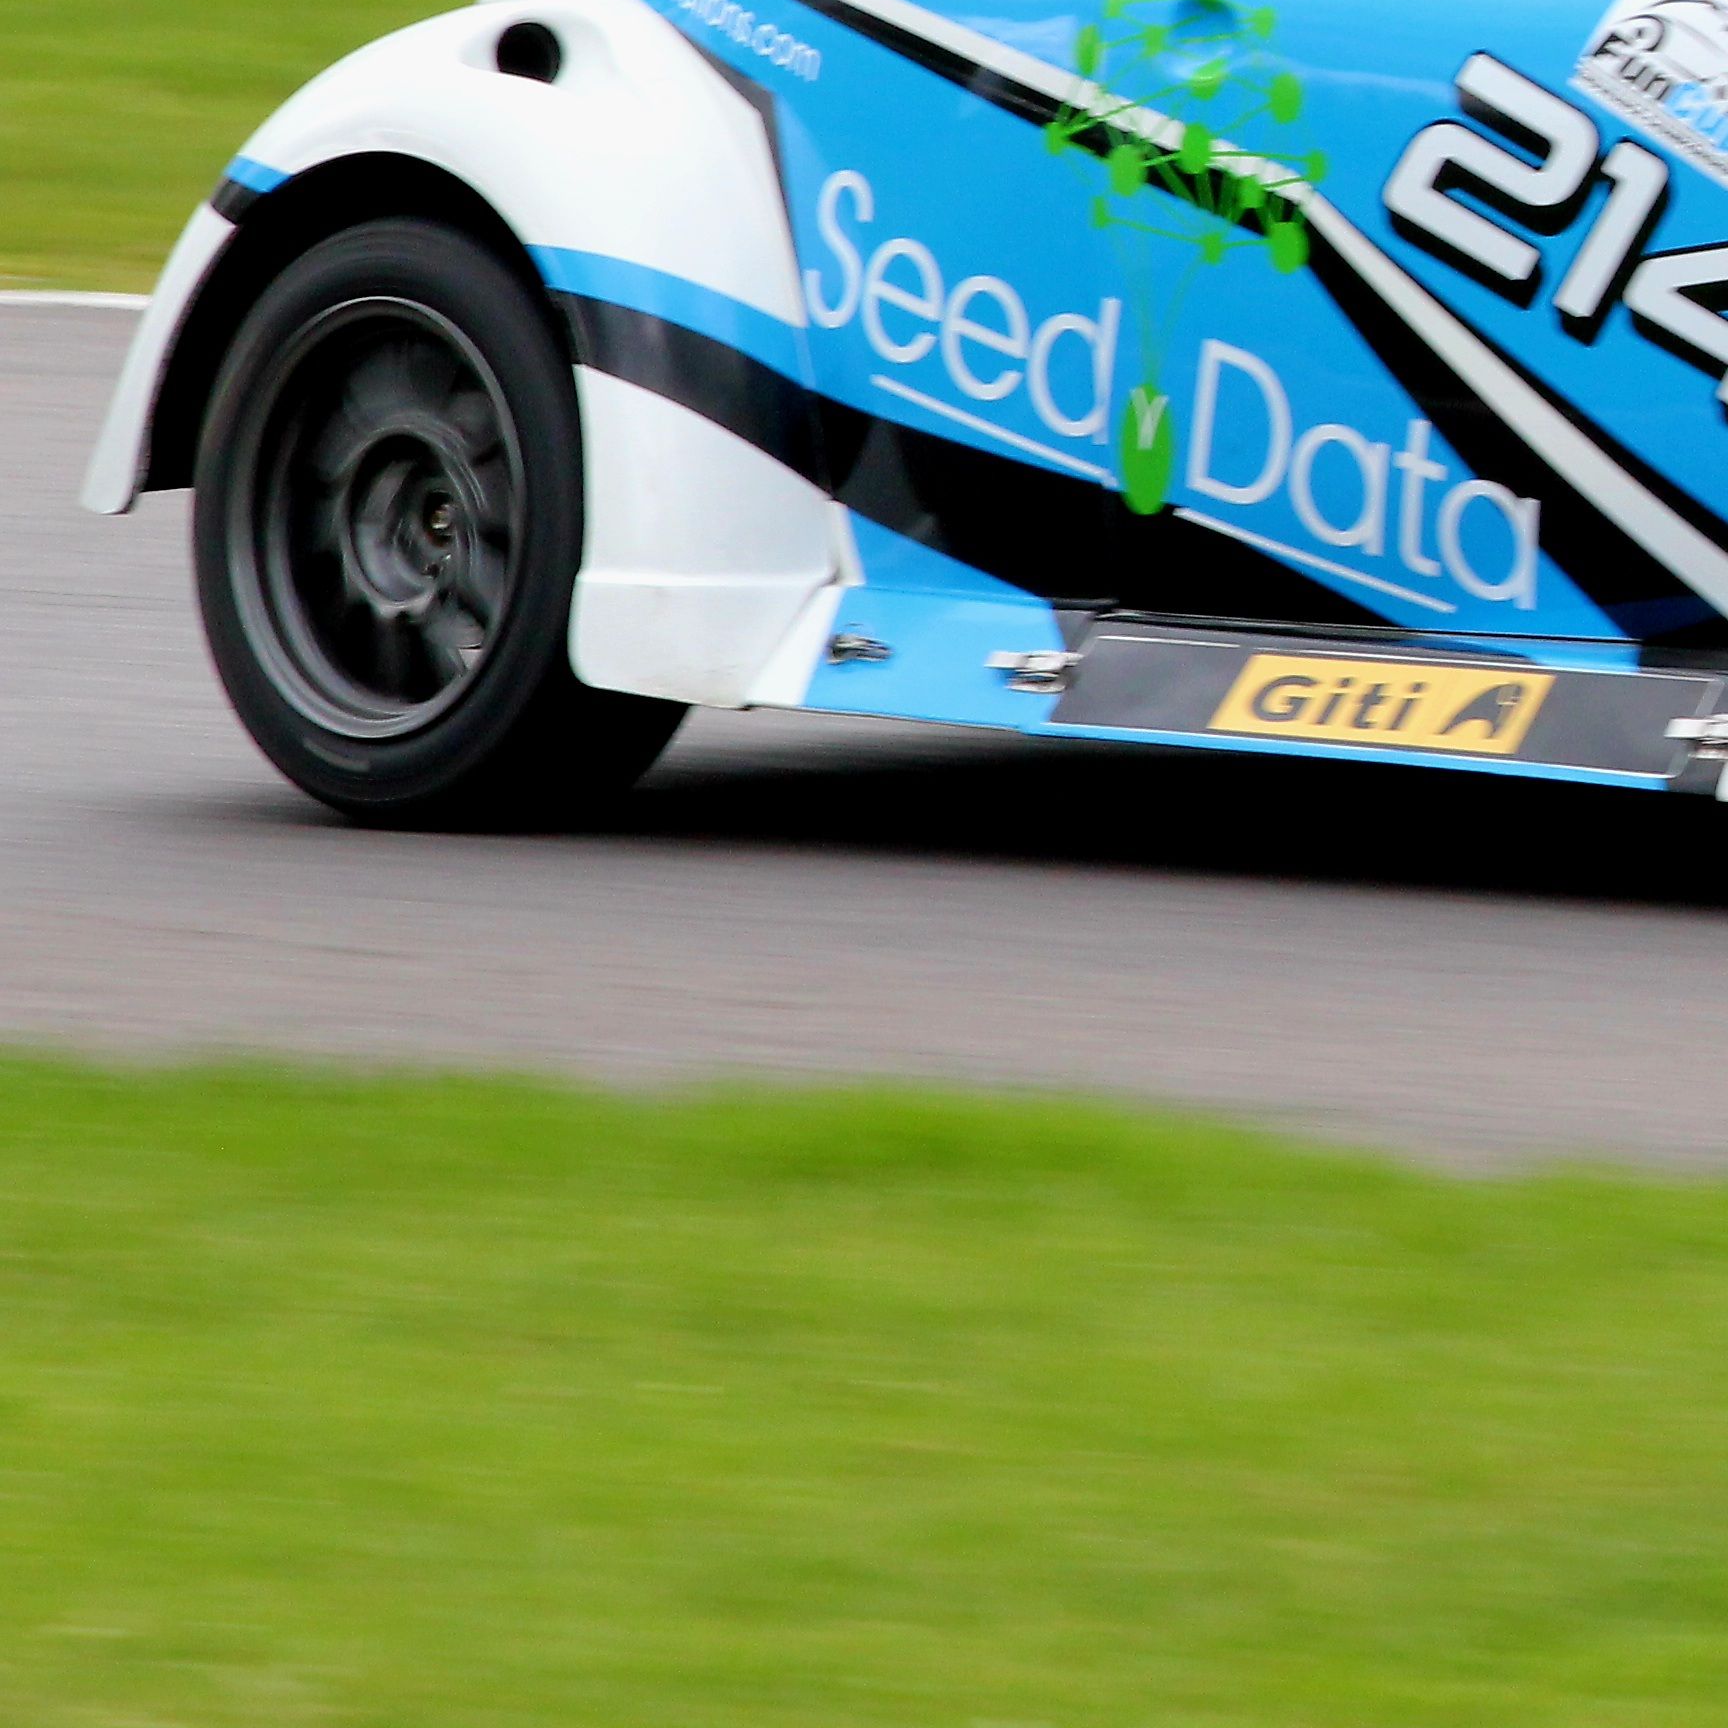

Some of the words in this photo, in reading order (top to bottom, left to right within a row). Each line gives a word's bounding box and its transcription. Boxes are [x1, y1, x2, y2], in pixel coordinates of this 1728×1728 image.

[803, 168, 1121, 447] Seed
[1186, 336, 1542, 612] Data
[1244, 674, 1425, 734] Giti
